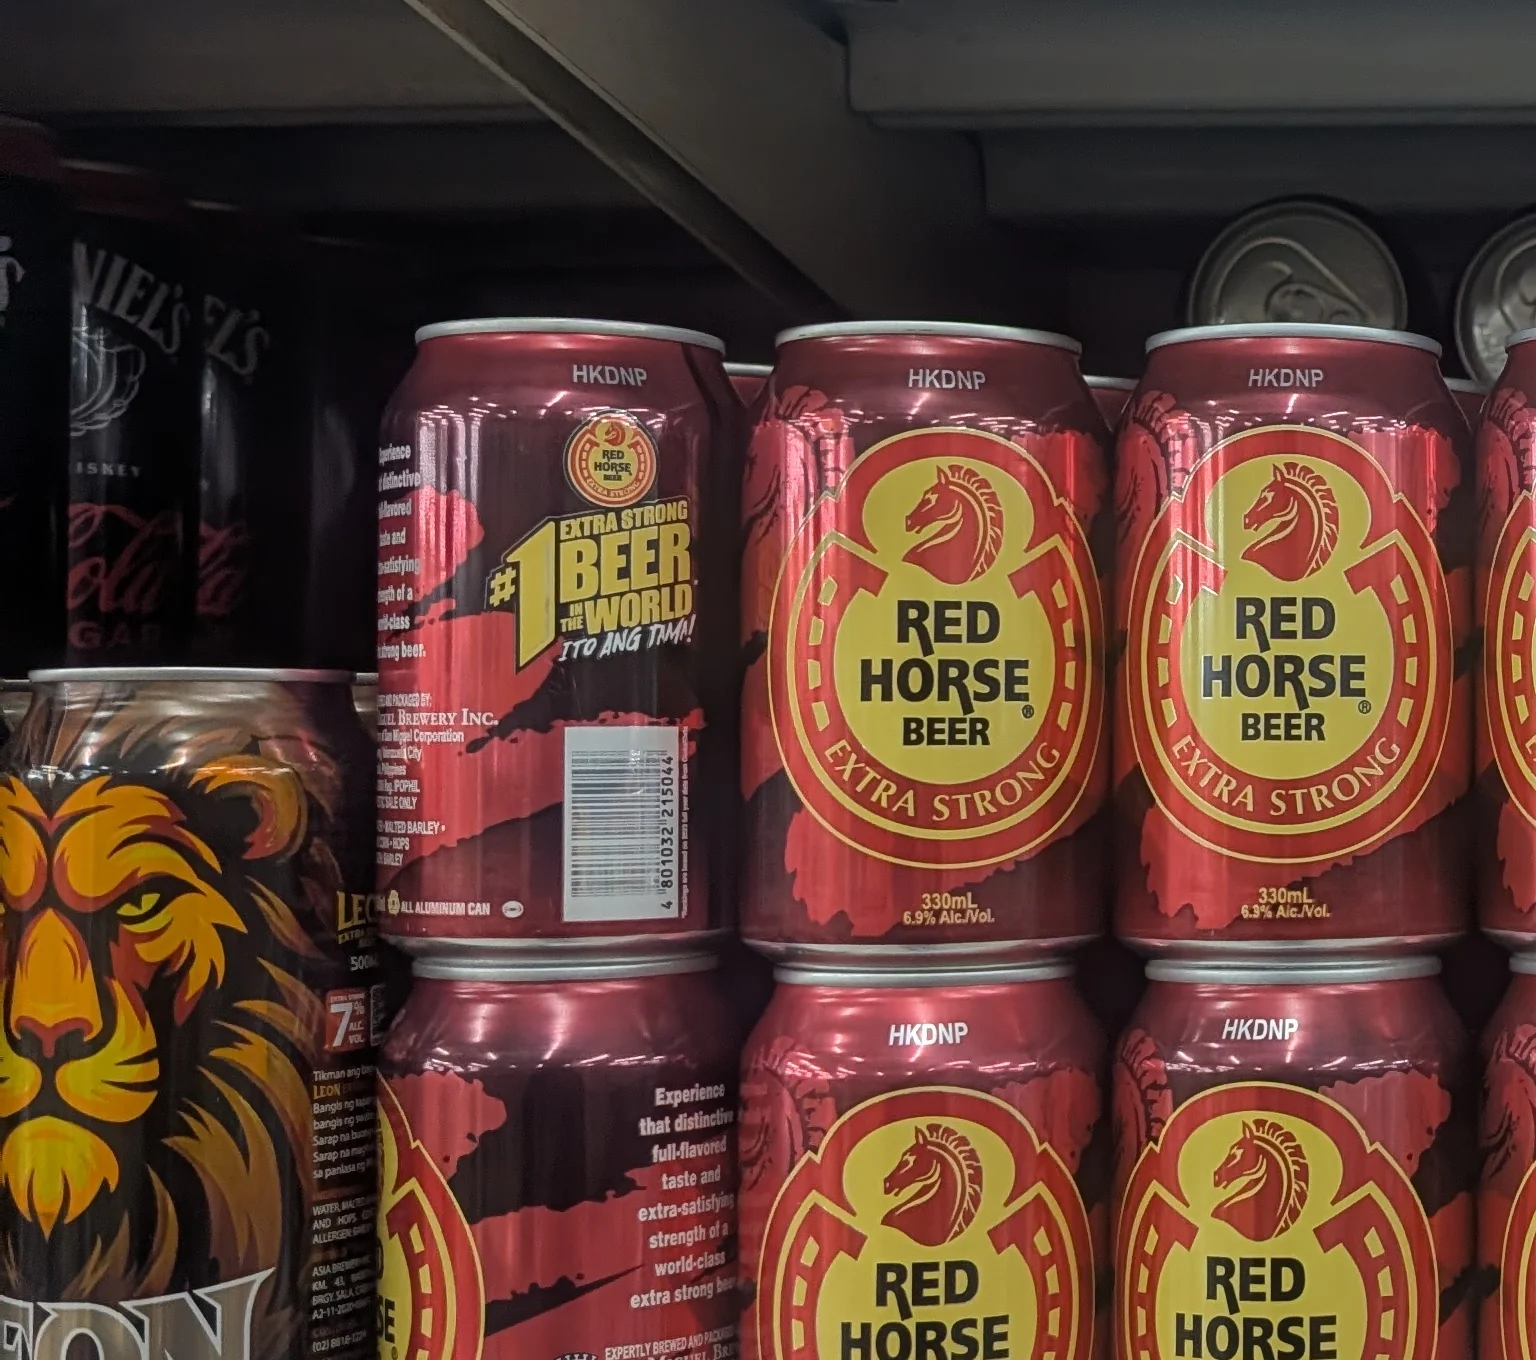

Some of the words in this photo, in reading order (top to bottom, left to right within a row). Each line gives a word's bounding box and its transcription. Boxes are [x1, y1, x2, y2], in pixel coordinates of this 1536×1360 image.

[572, 364, 647, 386] HKDNP
[908, 368, 987, 391] HKDNP
[1247, 368, 1324, 389] HKDNP
[560, 514, 619, 541] EXTRA
[622, 500, 688, 531] STRONG
[560, 522, 691, 604] BEER
[560, 617, 584, 633] THE
[585, 583, 693, 635] WORLD
[569, 602, 583, 617] IN
[559, 638, 596, 662] ITO
[599, 626, 641, 659] ANG
[896, 599, 1001, 656] RED
[859, 658, 1031, 716] HORSE
[902, 717, 990, 747] BEER
[824, 741, 916, 821] EXTRA
[932, 742, 1061, 822] STRONG
[922, 892, 977, 909] 330mL
[903, 909, 936, 926] 6.9%
[888, 1022, 968, 1047] HKDNP
[875, 1259, 979, 1321] RED
